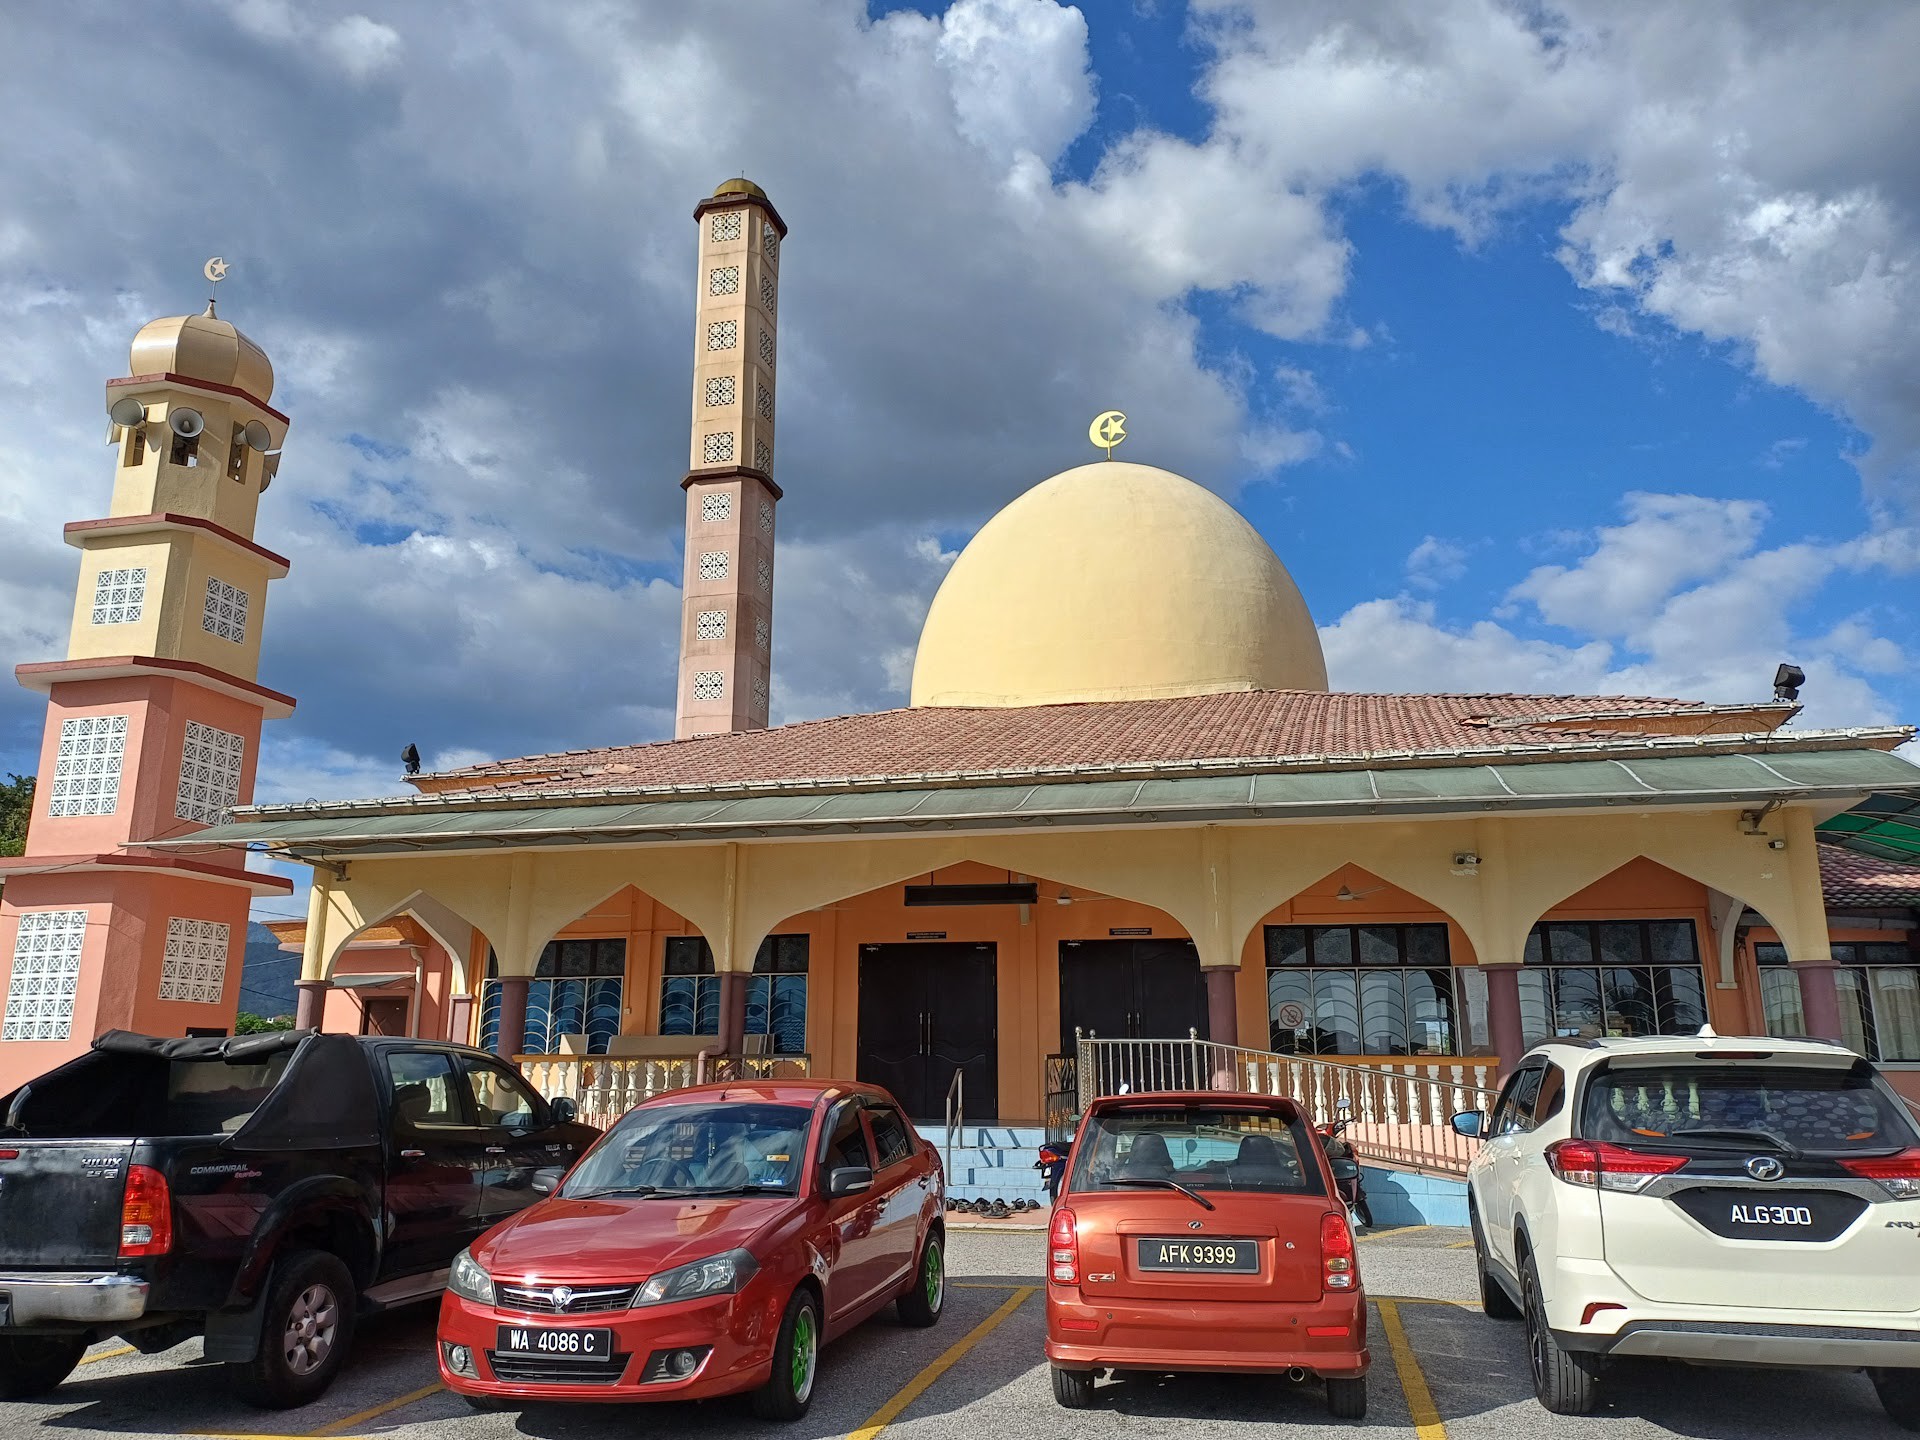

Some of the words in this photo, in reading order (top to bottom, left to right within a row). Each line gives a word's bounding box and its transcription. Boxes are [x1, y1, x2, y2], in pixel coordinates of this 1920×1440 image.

[81, 1157, 123, 1168] HILUX
[190, 1164, 249, 1174] COMMONRAIL
[234, 1170, 262, 1178] turbo
[1731, 1204, 1812, 1225] ALG300
[1159, 1244, 1190, 1263] AFK
[1193, 1245, 1236, 1264] 9399
[510, 1329, 529, 1350] WA
[538, 1331, 579, 1352] 4086
[583, 1333, 595, 1352] C
